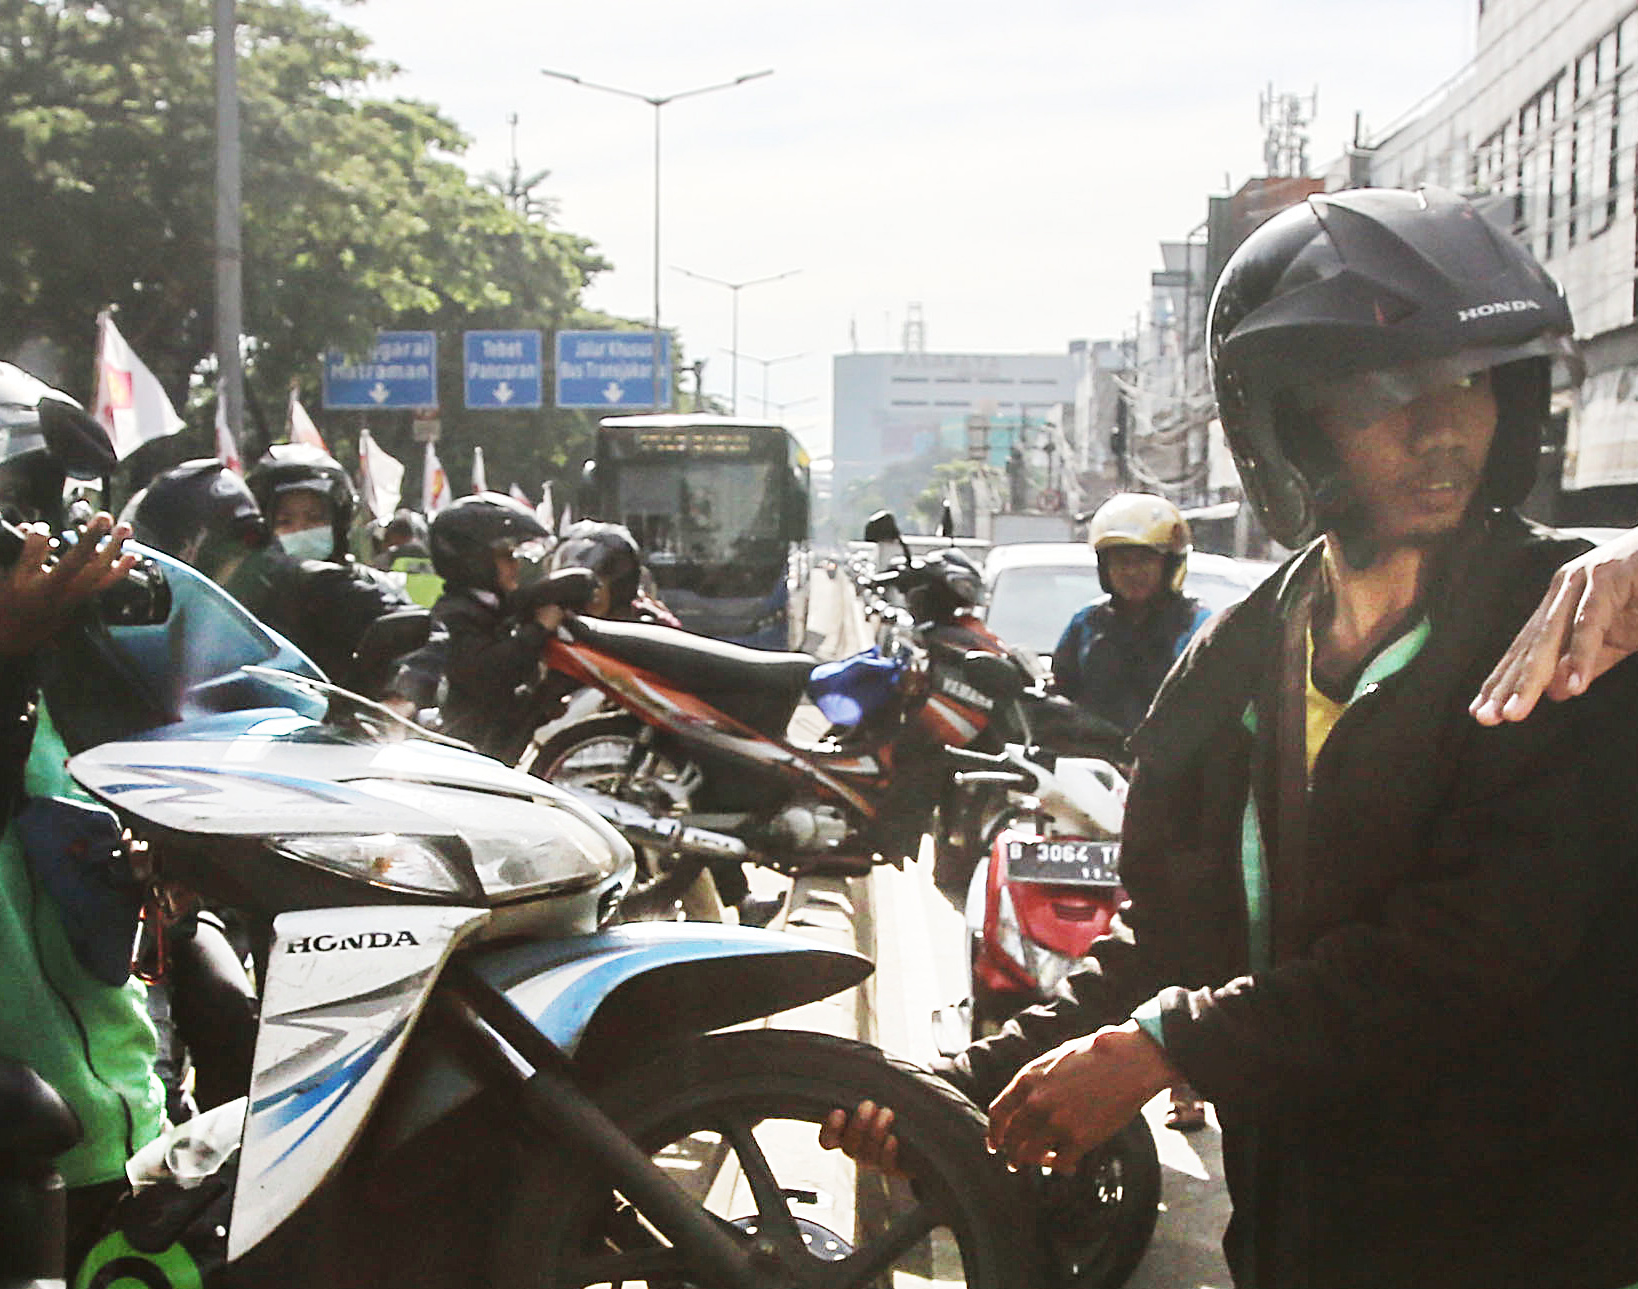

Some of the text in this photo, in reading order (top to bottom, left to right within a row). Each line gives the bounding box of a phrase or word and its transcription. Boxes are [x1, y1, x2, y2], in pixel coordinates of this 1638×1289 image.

[1458, 300, 1540, 322] HONDA
[585, 361, 666, 382] Transjakara
[1036, 843, 1089, 863] 3064
[285, 930, 420, 954] HONDA
